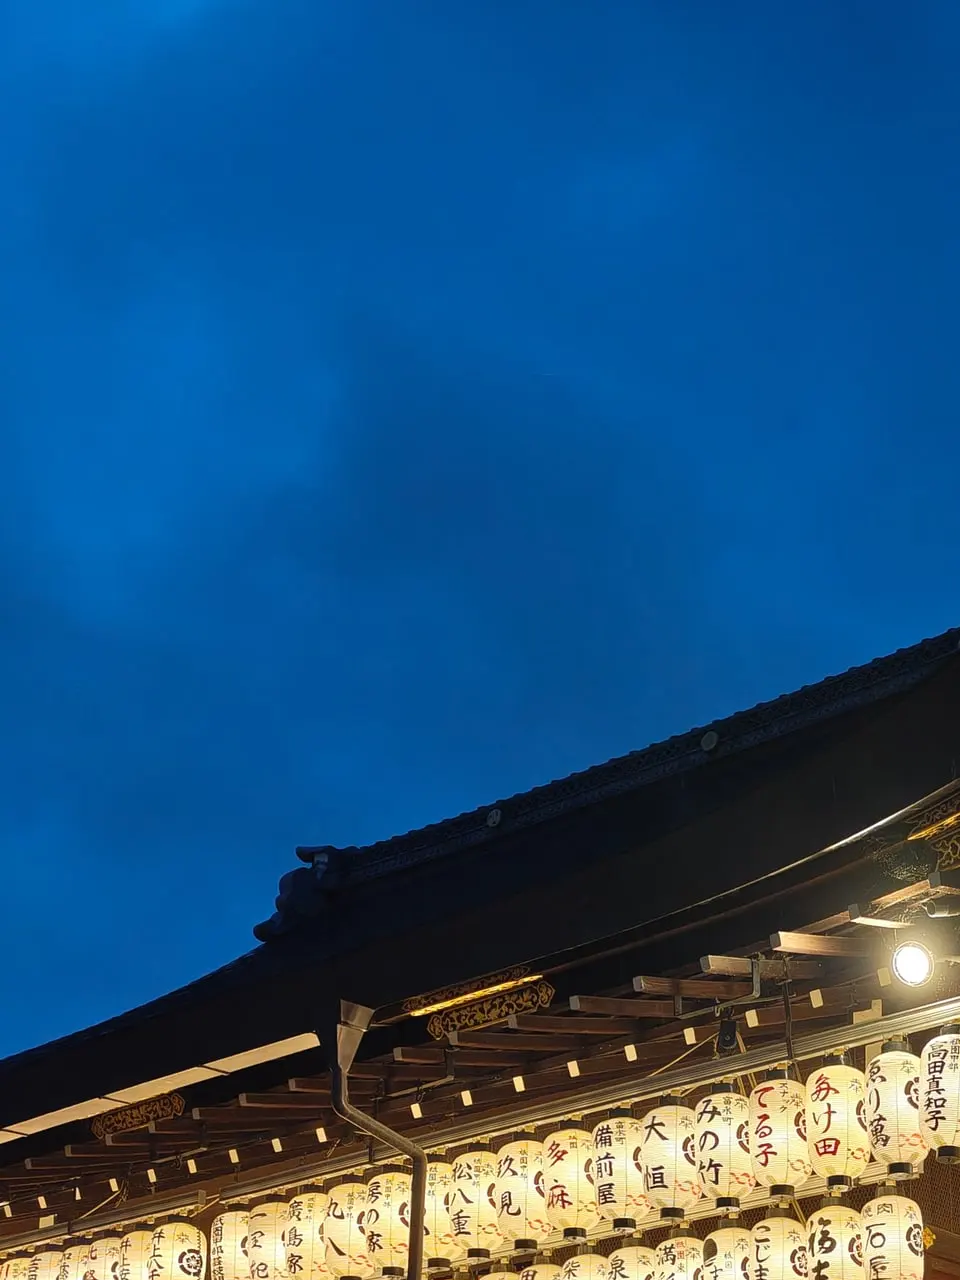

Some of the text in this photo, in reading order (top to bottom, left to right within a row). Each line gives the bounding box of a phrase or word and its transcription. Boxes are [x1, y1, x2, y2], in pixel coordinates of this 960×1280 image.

[753, 1086, 779, 1167] てる子
[777, 1082, 789, 1114] スナック
[593, 1125, 617, 1206] 備前屋
[696, 1098, 724, 1185] みの竹
[450, 1162, 474, 1237] 松八重
